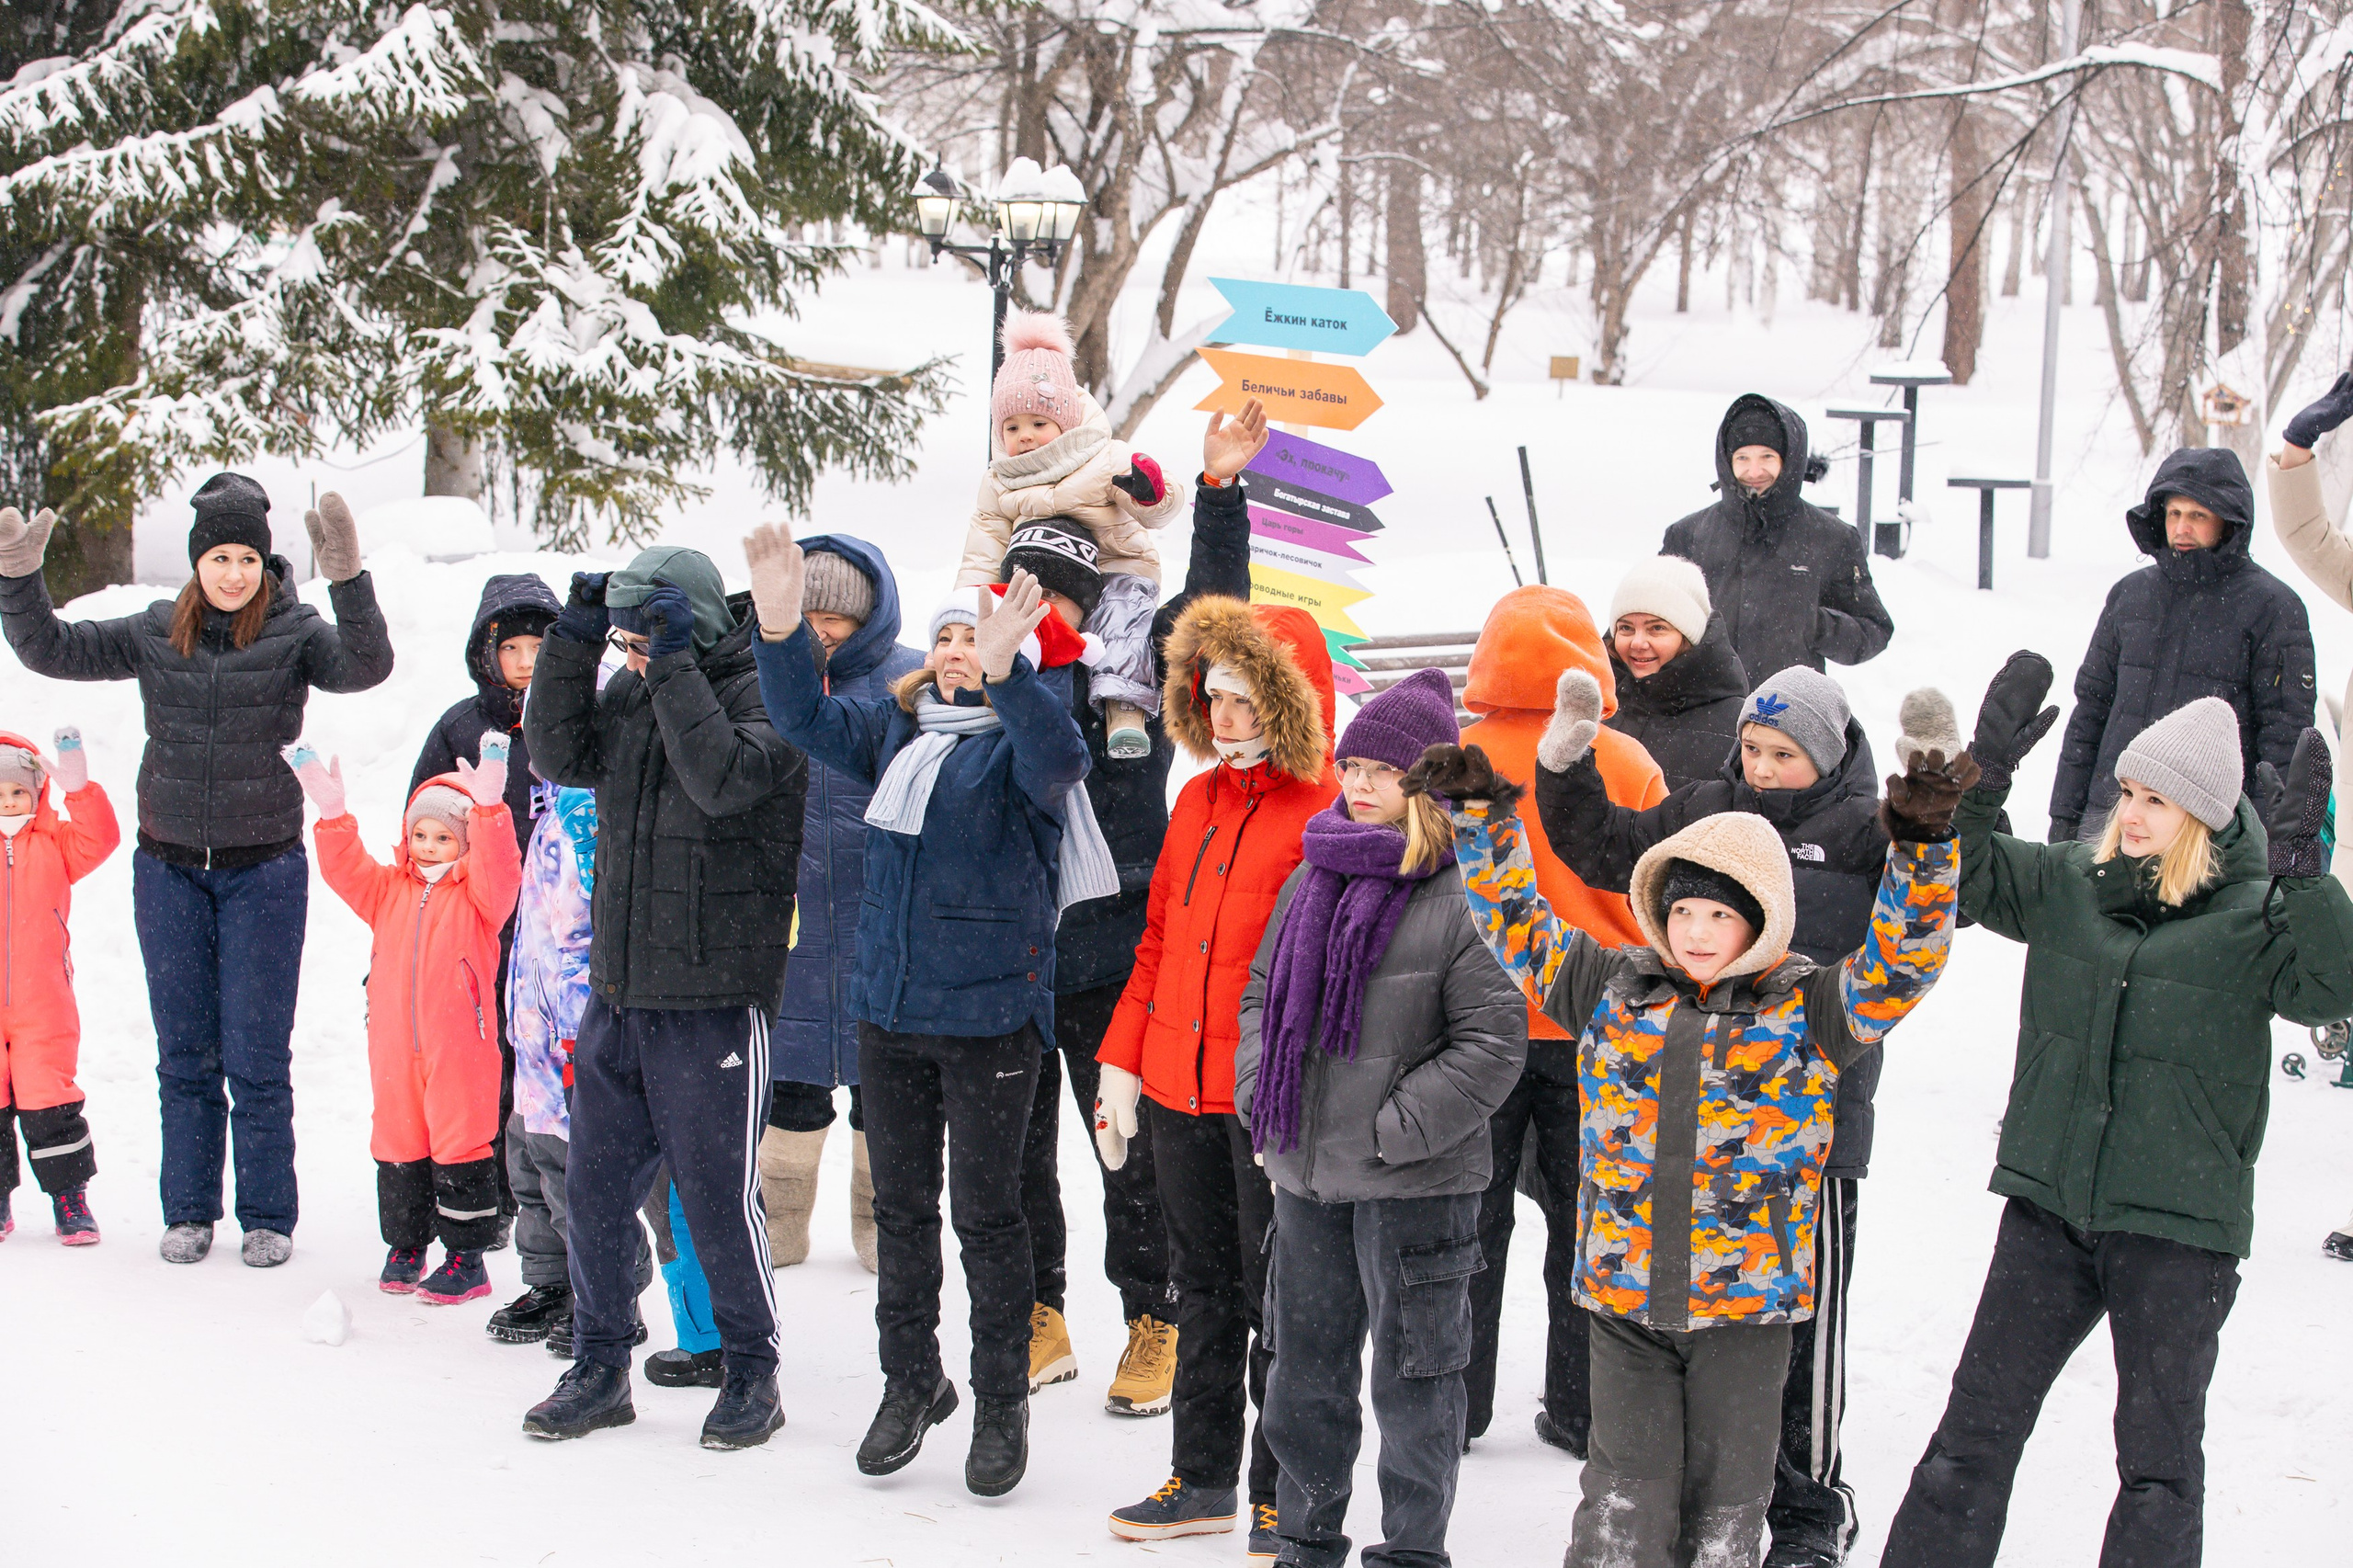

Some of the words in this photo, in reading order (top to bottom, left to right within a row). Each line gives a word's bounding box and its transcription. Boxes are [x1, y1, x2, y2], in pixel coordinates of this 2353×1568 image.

[1265, 307, 1306, 326] Ёжкин
[1311, 318, 1347, 331] каток
[1242, 379, 1295, 397] Беличьи
[1300, 389, 1347, 404] забавы
[1262, 517, 1281, 529] Царь
[1283, 524, 1303, 535] горы
[1250, 545, 1323, 569] аричок-лесовичок
[1298, 595, 1322, 607] игры
[1334, 674, 1351, 684] ньки
[1748, 712, 1779, 727] adidas
[1790, 846, 1814, 856] NORTH
[720, 1060, 744, 1068] adidas
